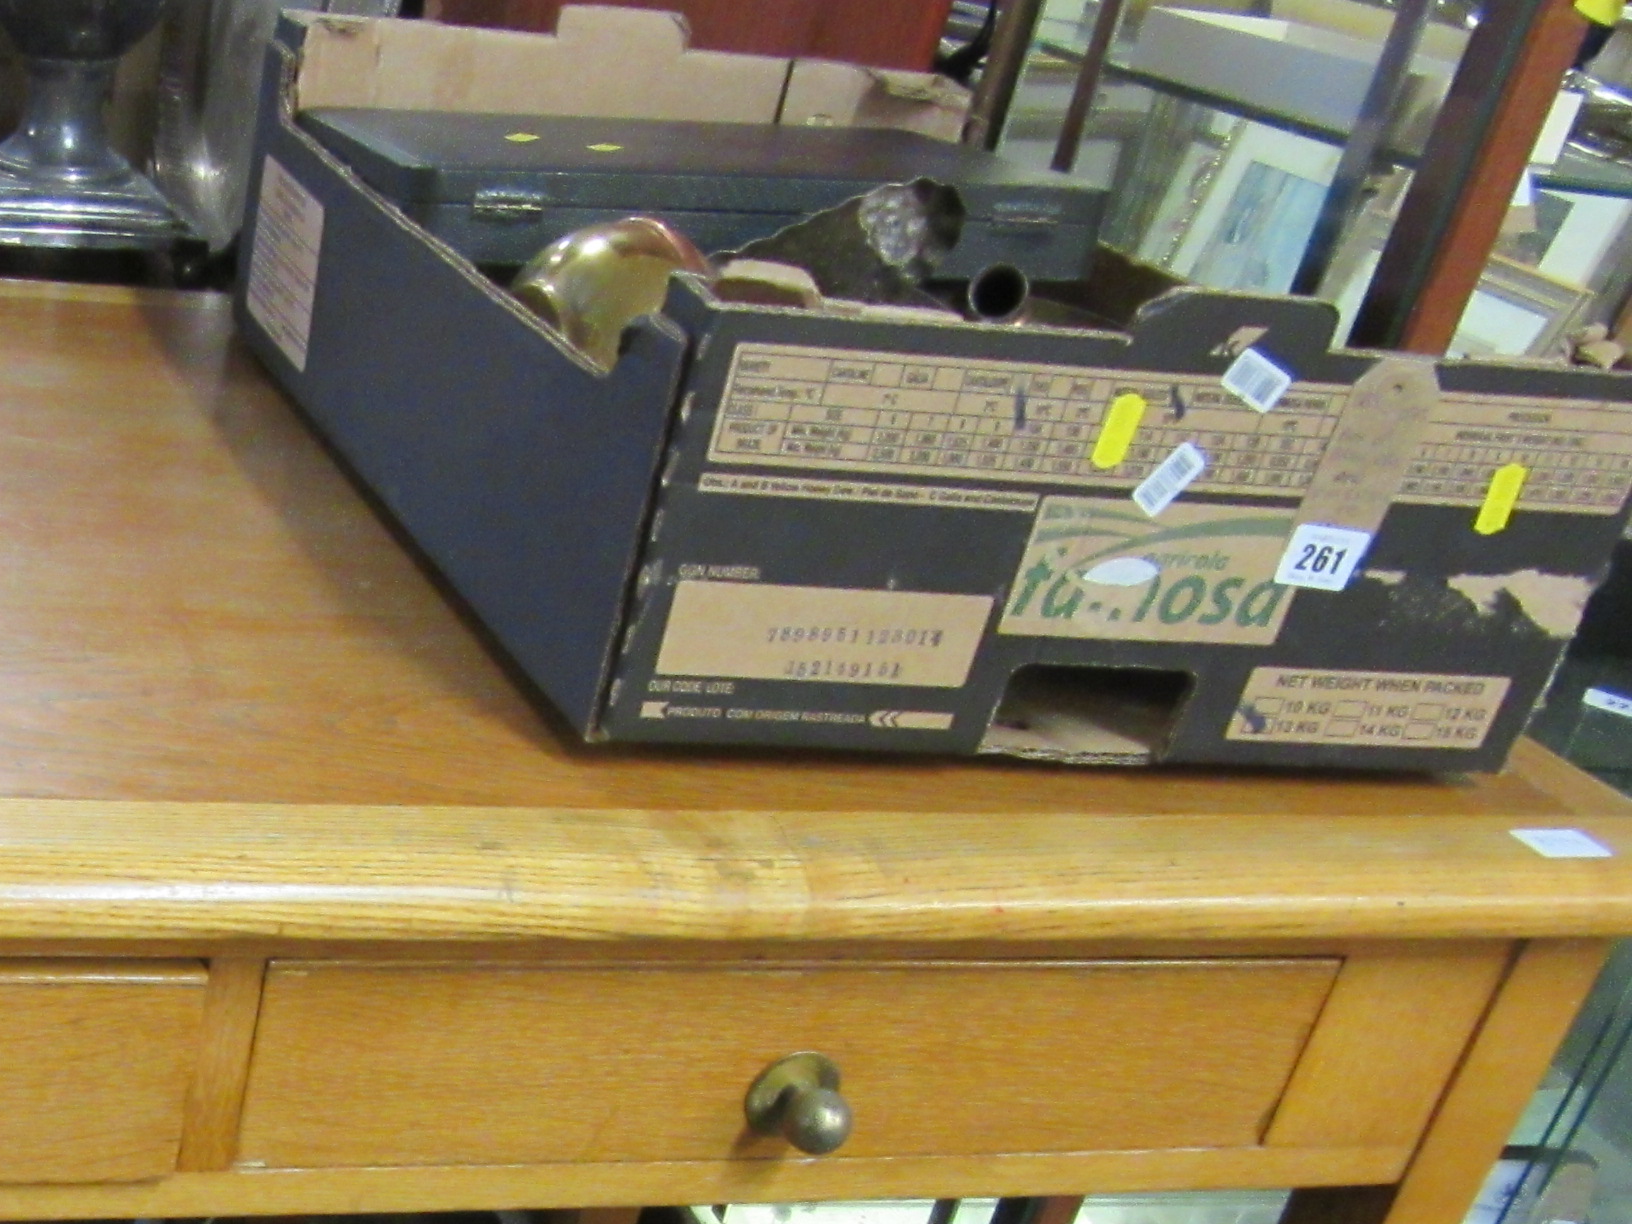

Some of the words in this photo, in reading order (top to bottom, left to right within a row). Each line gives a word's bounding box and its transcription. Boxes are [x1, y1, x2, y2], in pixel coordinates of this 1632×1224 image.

[1295, 543, 1349, 575] 261
[1276, 674, 1311, 689] NET
[1312, 675, 1372, 691] WEIGHT
[1375, 678, 1421, 693] WHEN
[1423, 680, 1486, 695] PACKED
[1306, 701, 1331, 714] KG
[1387, 705, 1411, 718] KG
[1465, 709, 1487, 721] KG
[1296, 721, 1319, 734] KG
[1376, 724, 1402, 737] KG
[1454, 728, 1478, 740] KG
